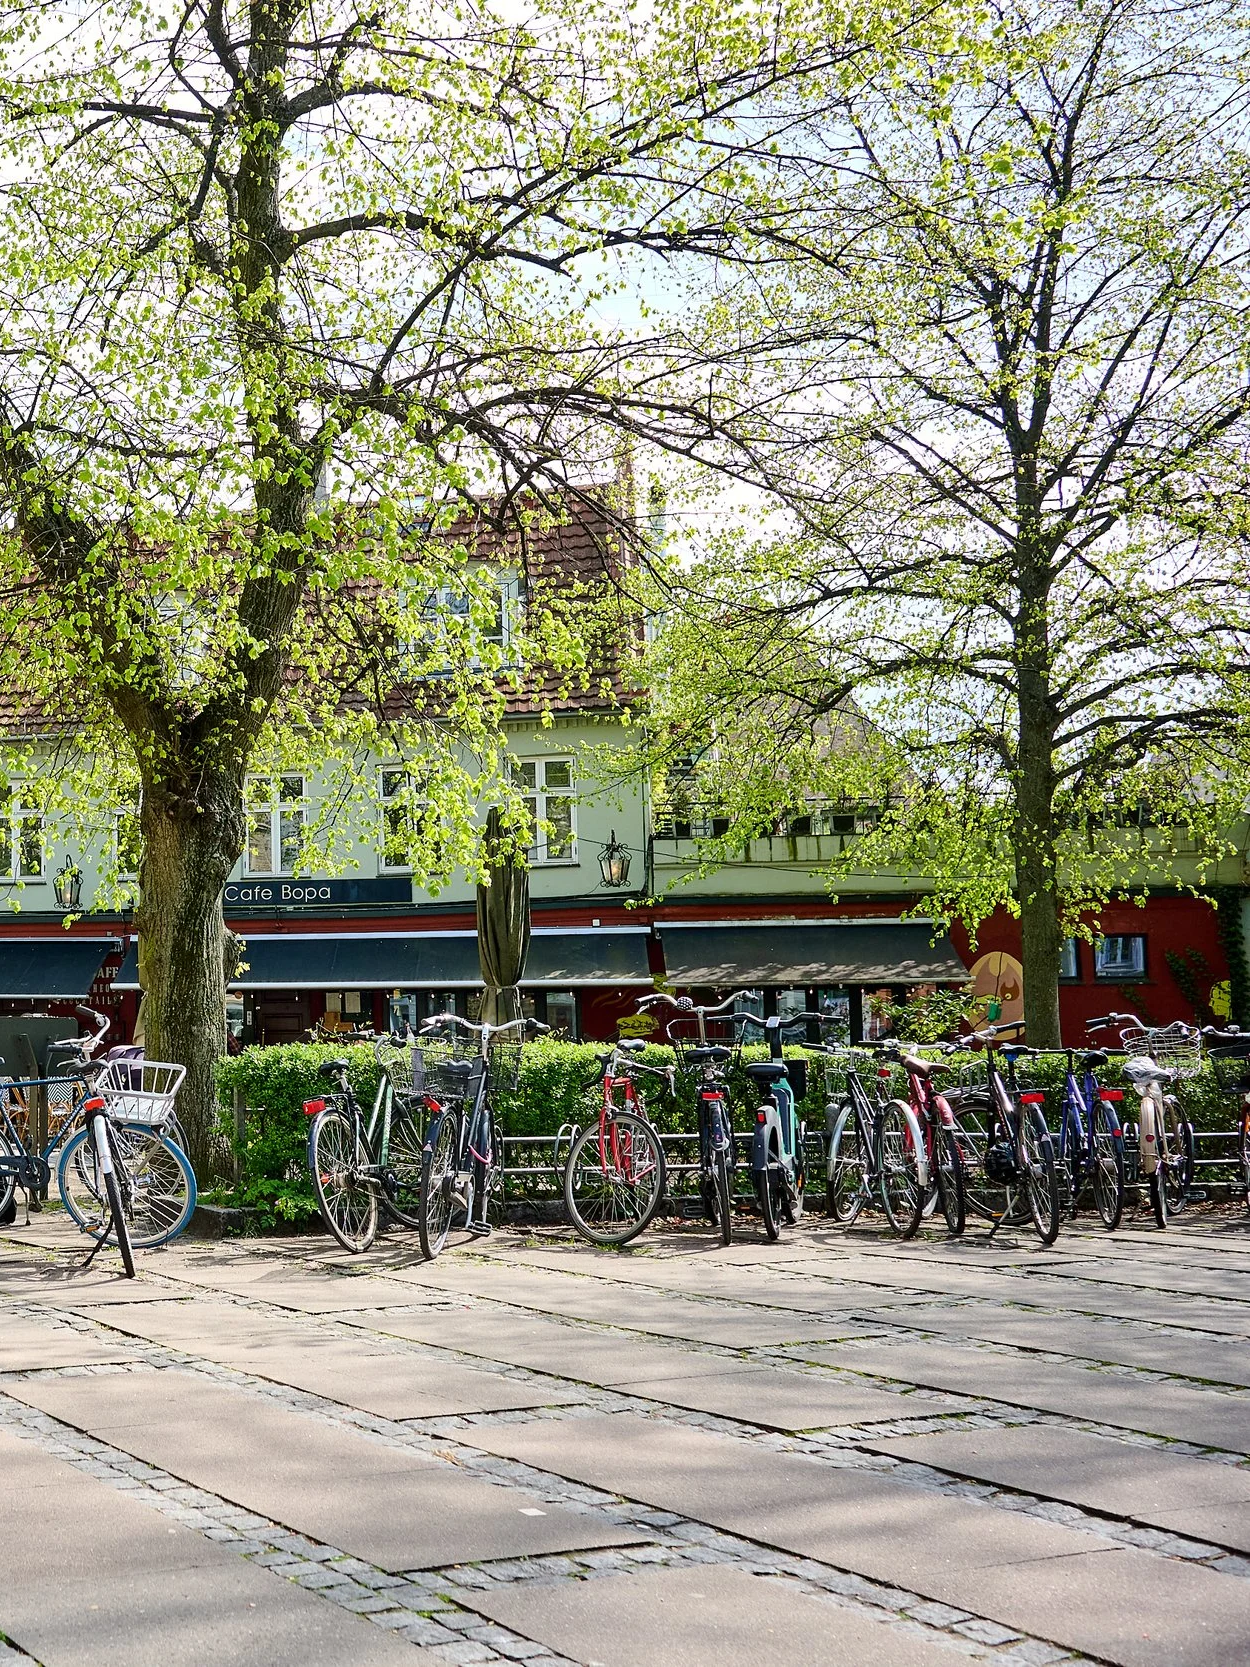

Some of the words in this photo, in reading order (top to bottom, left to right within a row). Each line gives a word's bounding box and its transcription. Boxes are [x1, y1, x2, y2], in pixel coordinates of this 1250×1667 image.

[224, 885, 273, 901] Cafe
[281, 884, 331, 902] Bopa
[97, 966, 119, 978] AFF
